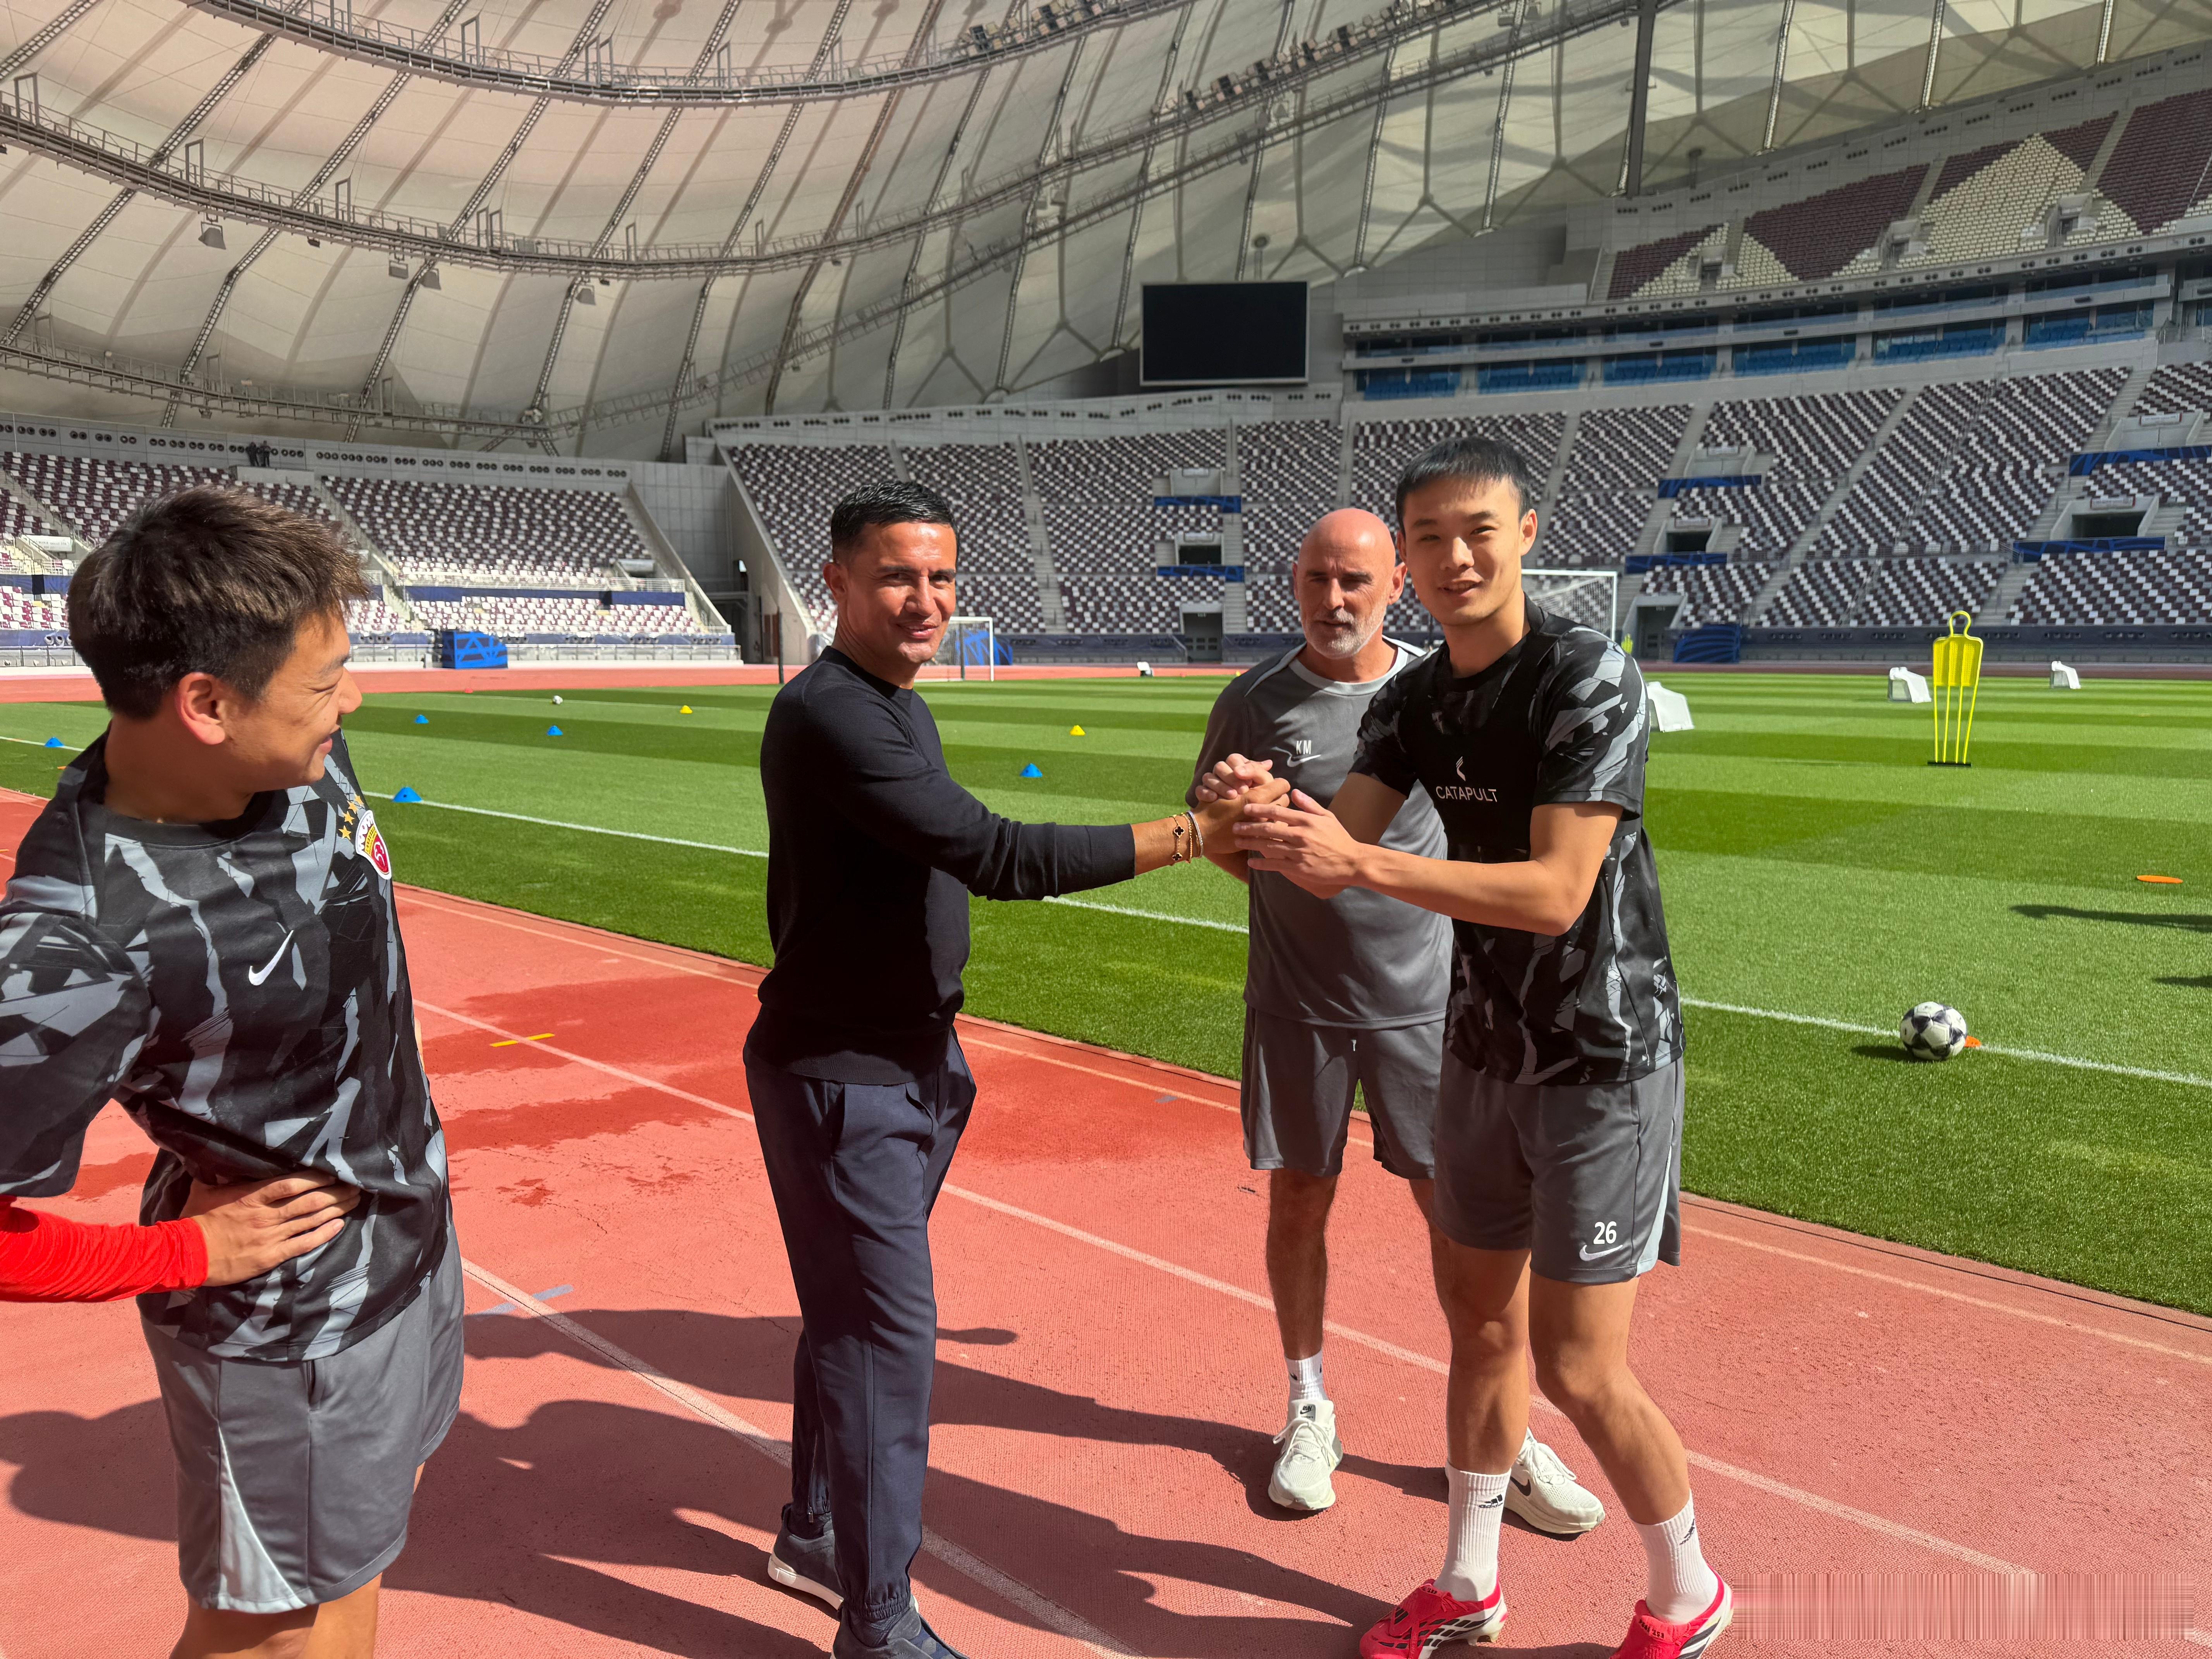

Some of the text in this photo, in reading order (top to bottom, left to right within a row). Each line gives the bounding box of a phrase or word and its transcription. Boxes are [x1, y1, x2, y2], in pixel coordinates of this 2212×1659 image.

[1296, 739, 1312, 755] KM
[1435, 786, 1498, 802] CATAPULT
[1593, 1221, 1617, 1245] 26
